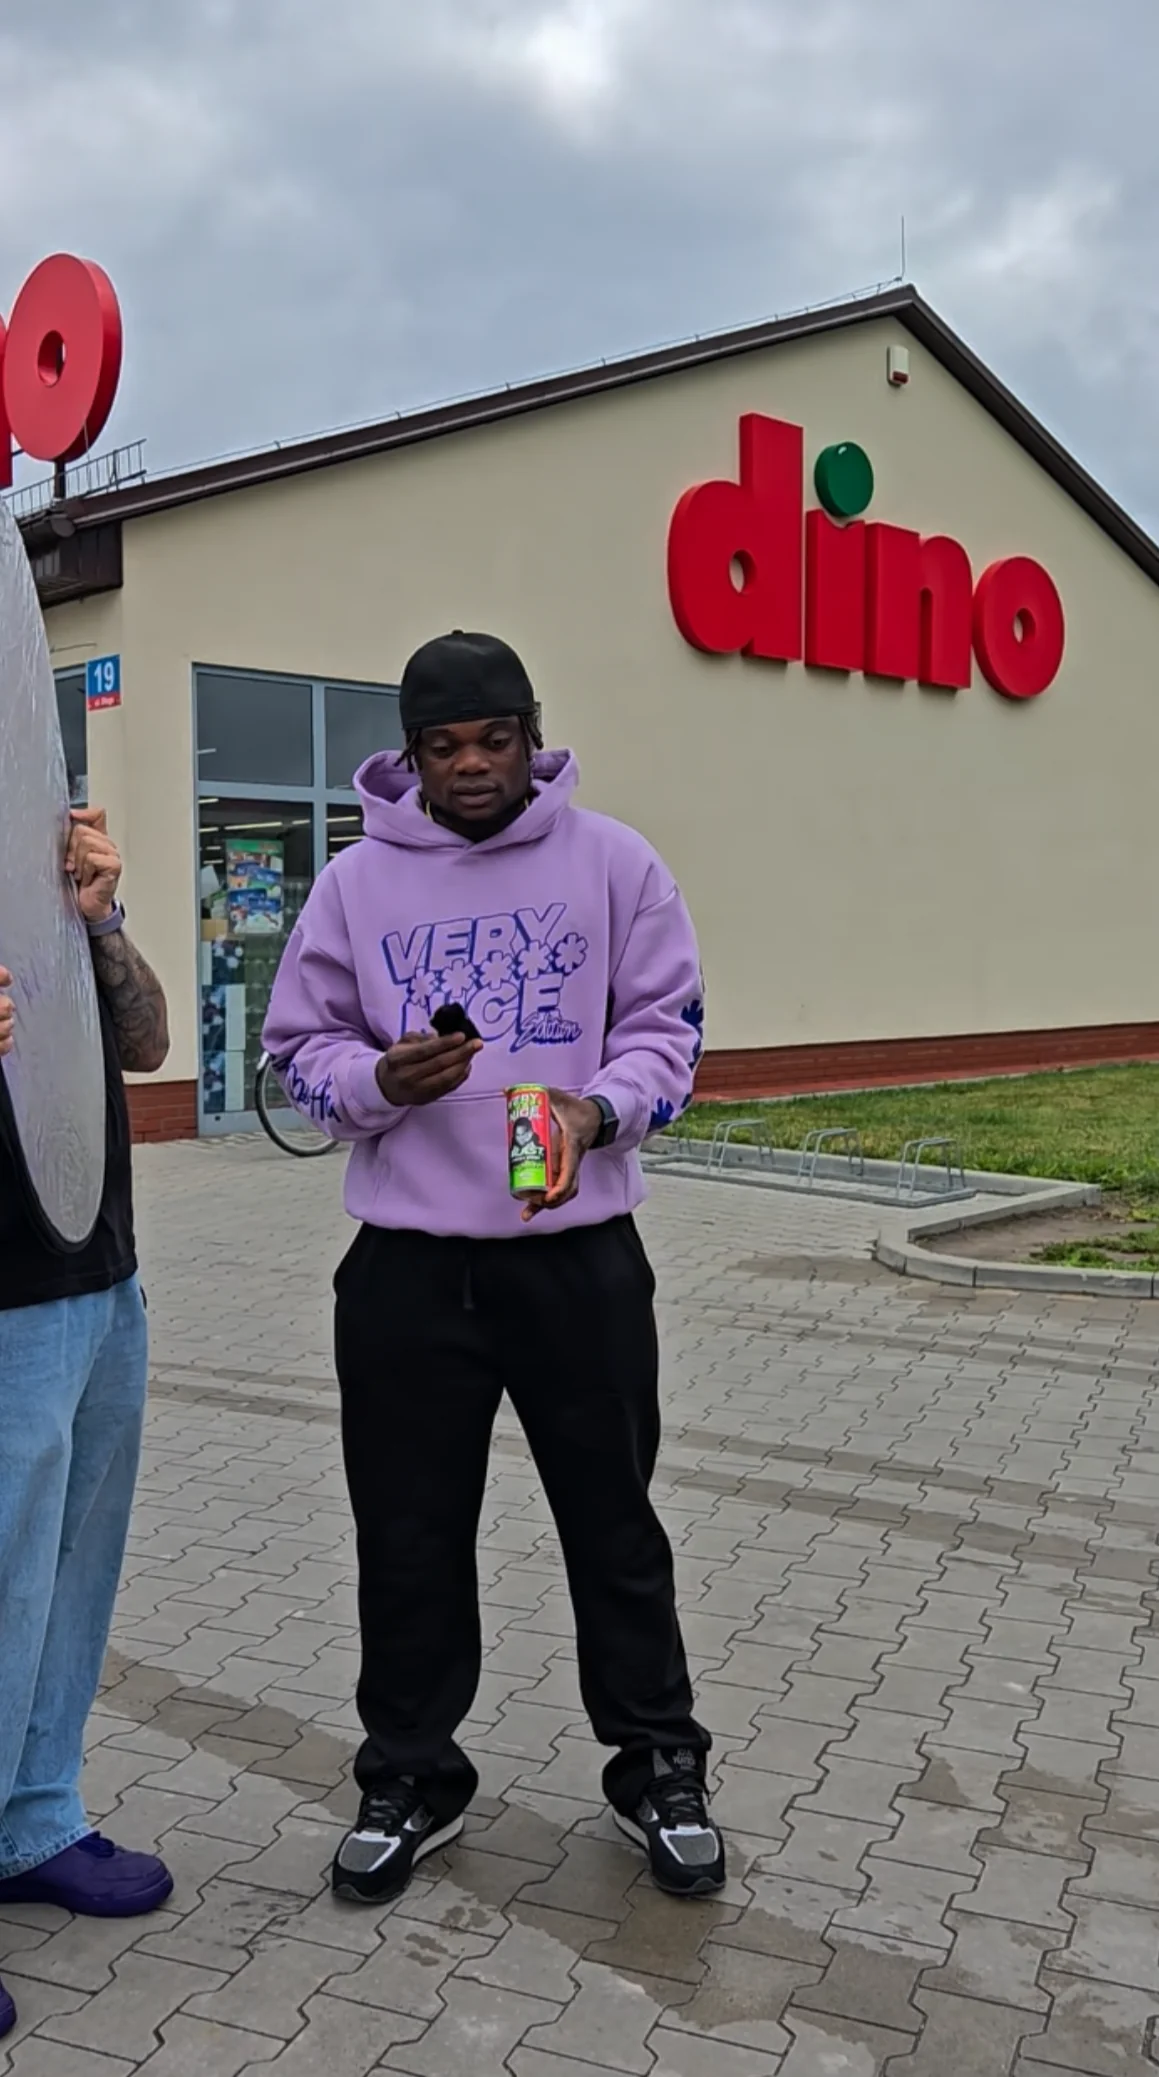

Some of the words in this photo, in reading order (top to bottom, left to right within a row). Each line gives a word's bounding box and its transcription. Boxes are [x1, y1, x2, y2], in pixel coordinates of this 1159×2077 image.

[668, 413, 1065, 699] dino
[94, 661, 115, 693] 19
[382, 903, 567, 985] VERY
[402, 973, 564, 1042] NCE
